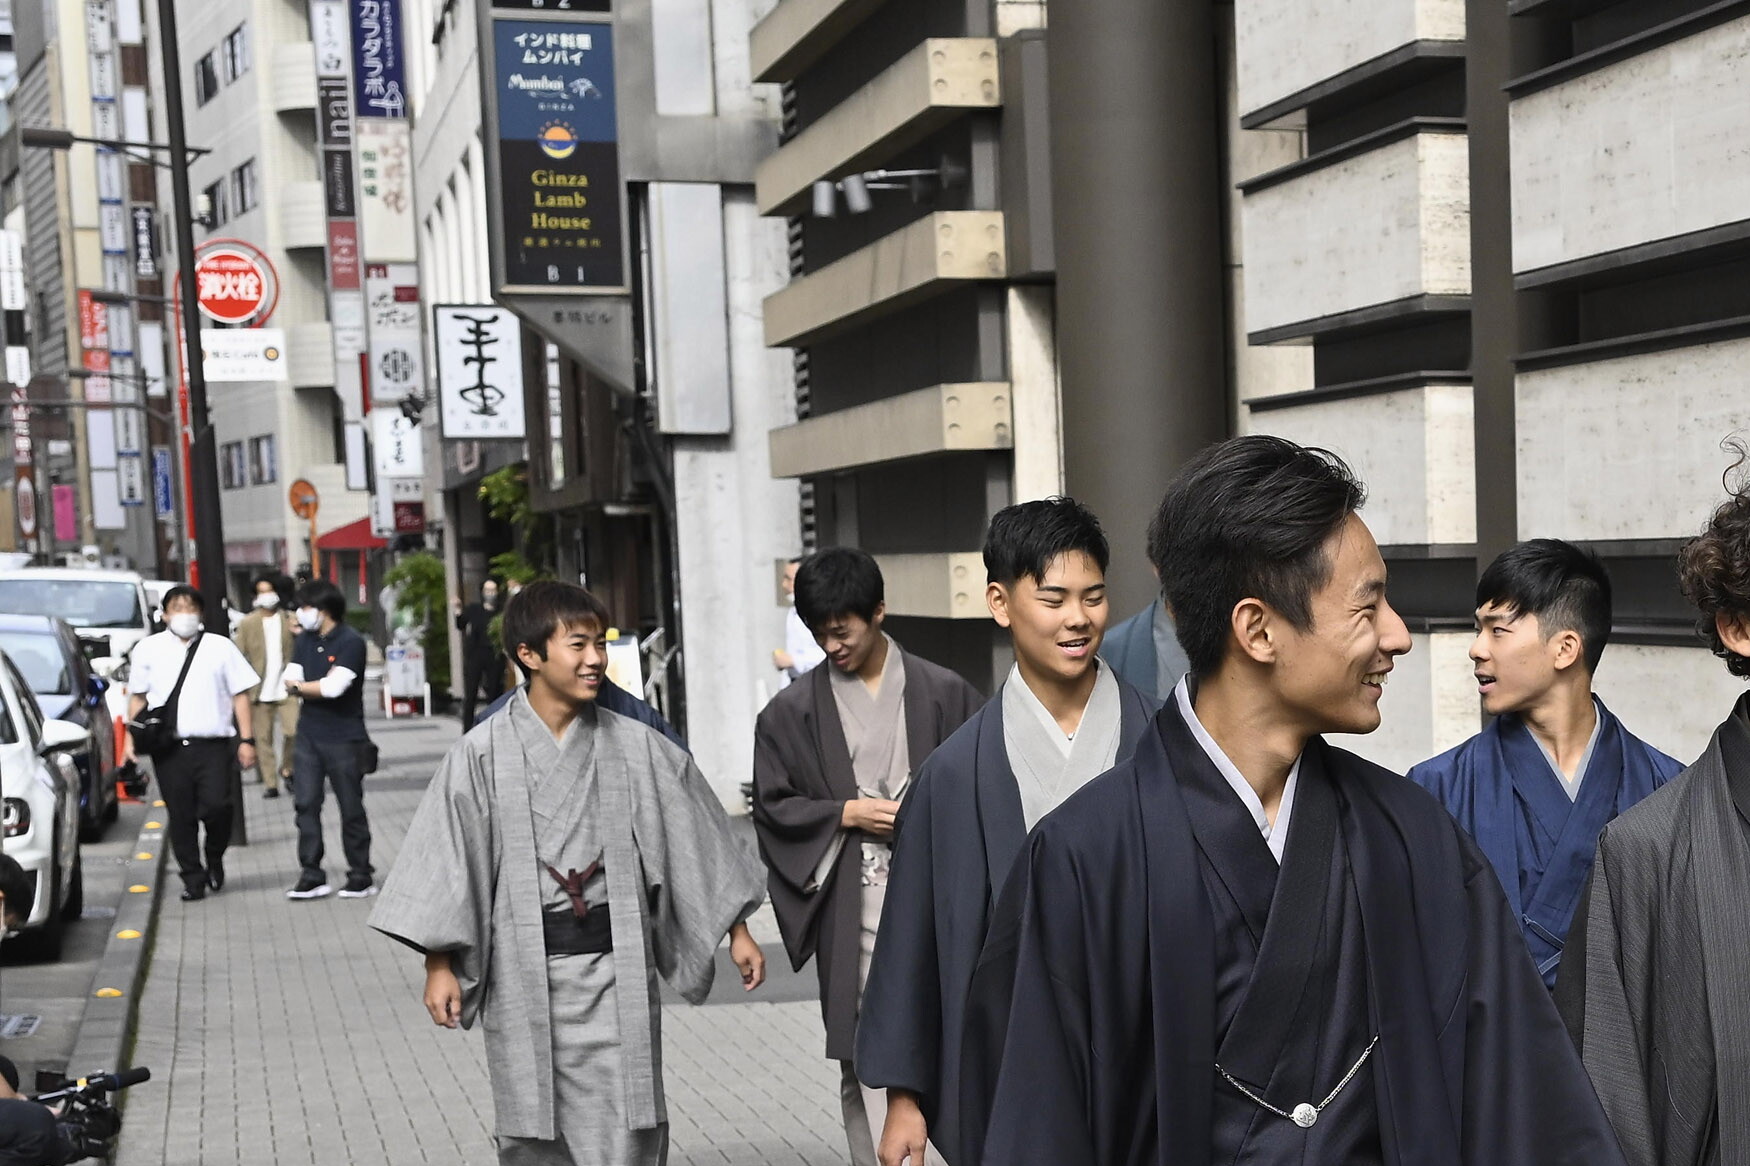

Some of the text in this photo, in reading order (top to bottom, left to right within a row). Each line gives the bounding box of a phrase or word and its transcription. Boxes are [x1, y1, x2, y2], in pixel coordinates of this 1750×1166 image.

[320, 79, 350, 137] nail
[530, 169, 589, 188] Ginza
[533, 191, 588, 208] Lamb
[531, 212, 592, 230] House
